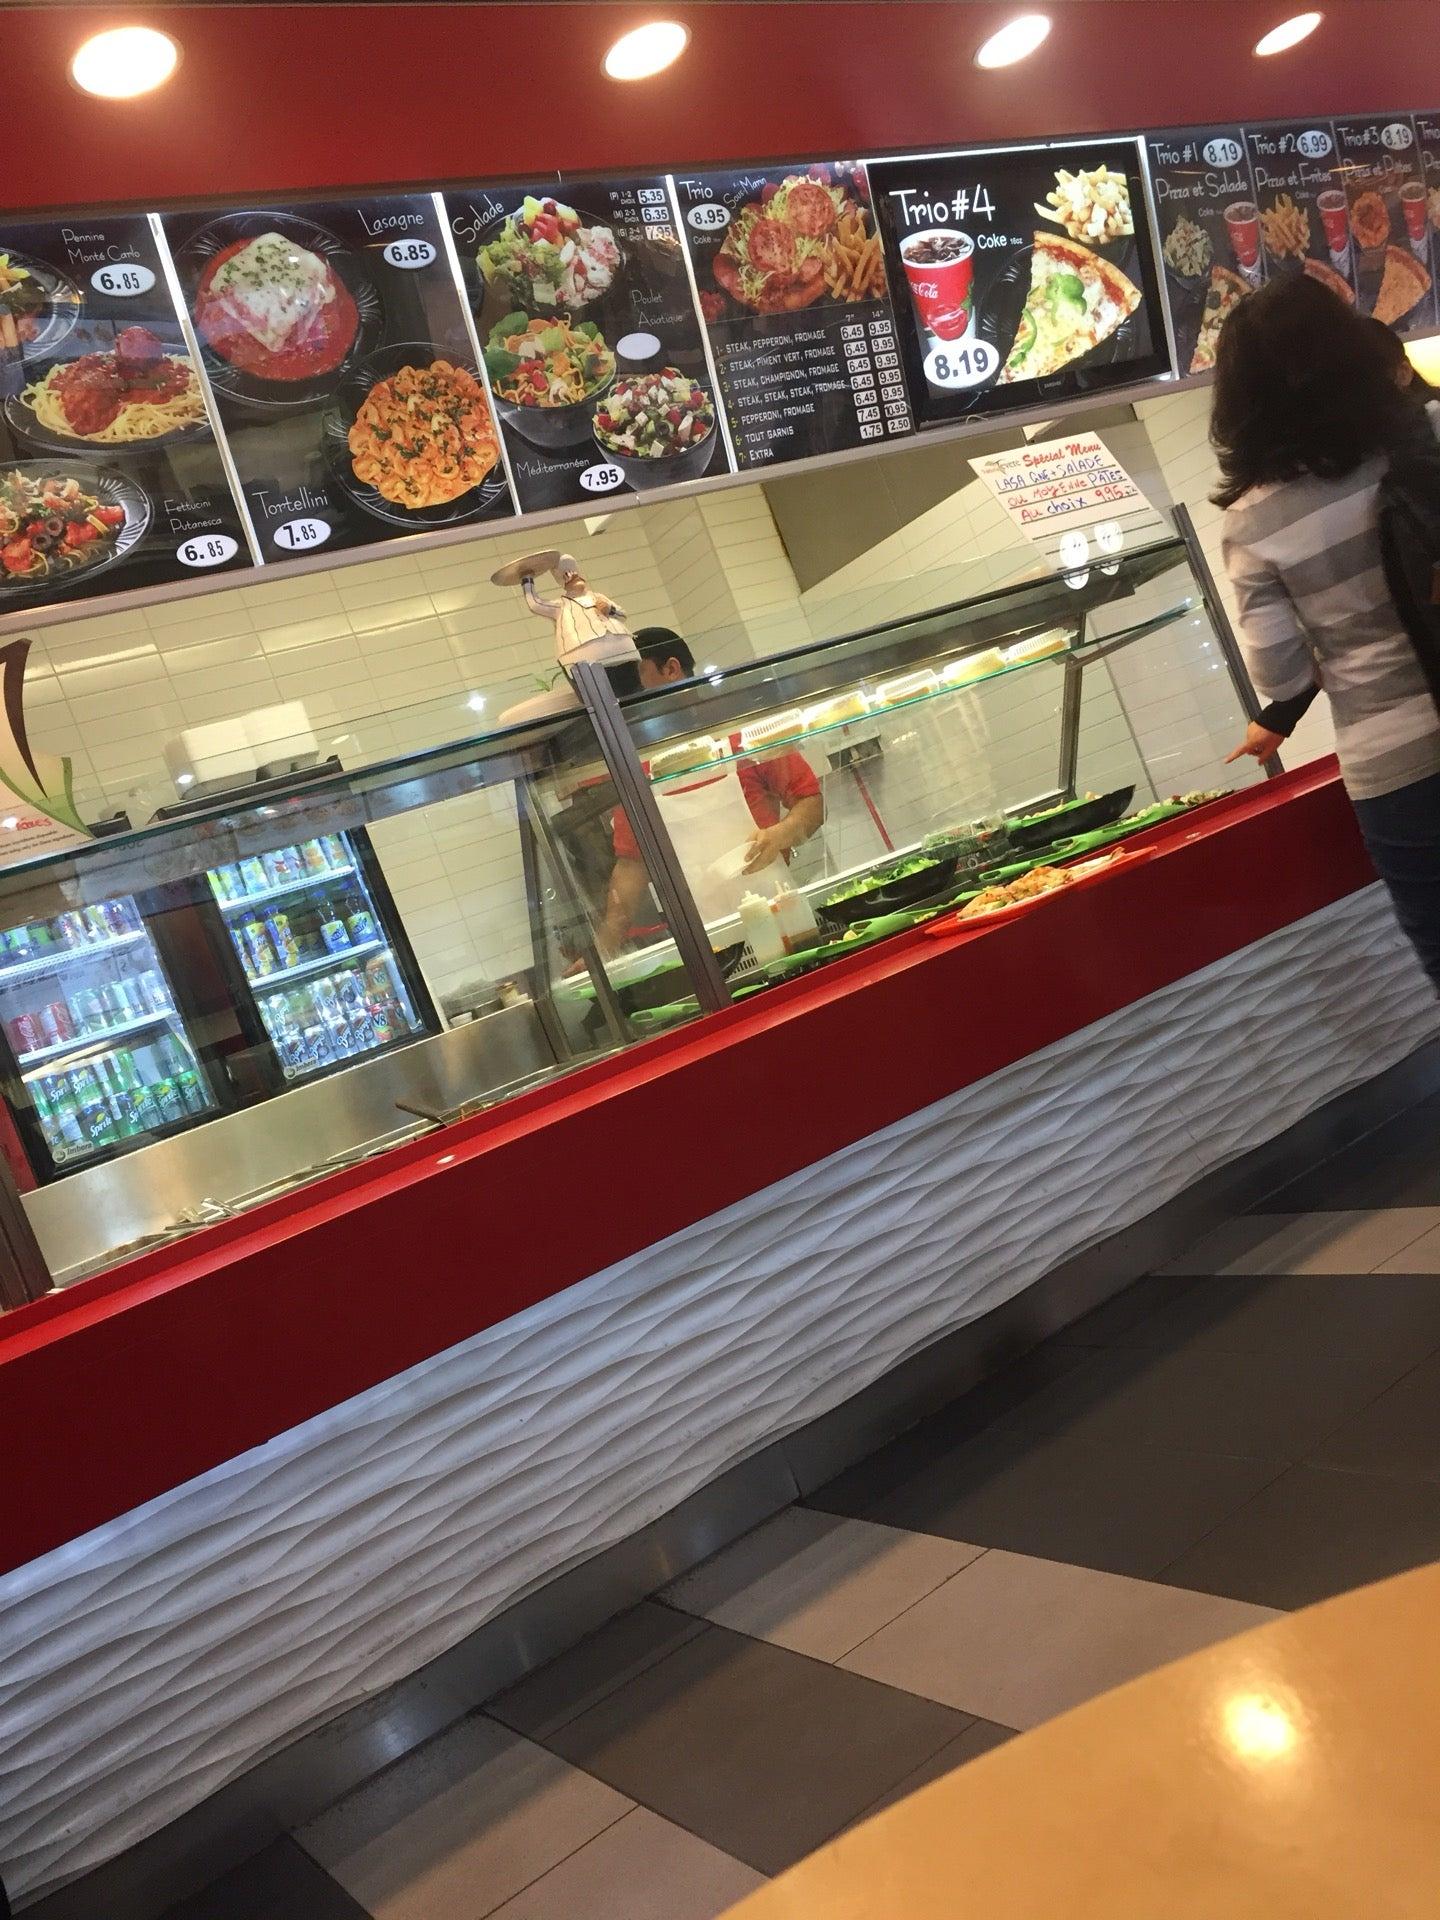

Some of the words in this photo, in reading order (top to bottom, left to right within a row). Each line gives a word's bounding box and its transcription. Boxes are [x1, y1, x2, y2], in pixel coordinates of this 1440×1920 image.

[1248, 134, 1277, 155] Trio
[1300, 134, 1328, 154] 6.99
[1385, 128, 1410, 146] 8.19
[1149, 143, 1180, 165] Trio
[1182, 142, 1199, 163] #1
[1207, 143, 1238, 163] 8.19
[1155, 178, 1190, 204] Pizza
[1192, 181, 1205, 197] et
[1204, 169, 1248, 197] Salade
[1254, 167, 1285, 192] Pizza
[1287, 170, 1299, 186] et
[1298, 162, 1332, 187] Frites
[640, 190, 663, 204] 5.35
[679, 180, 714, 200] Trio
[357, 208, 425, 236] Lasagne
[452, 194, 505, 243] Salade
[644, 208, 668, 222] 6.35
[694, 208, 725, 225] 8.95
[61, 228, 105, 245] Pennine
[693, 234, 712, 245] Coke
[976, 233, 1007, 250] Coke
[106, 244, 141, 262] Carlo
[390, 244, 431, 263] 6.85
[100, 272, 140, 291] 6.85
[631, 288, 664, 307] Poulet
[638, 311, 683, 328] Asiatique
[842, 326, 863, 339] 6.45
[870, 321, 890, 335] 9.95
[726, 340, 752, 354] STEAK,
[752, 334, 794, 350] PEPPERONI,
[794, 329, 826, 342] FROMAGE
[845, 342, 866, 356] 6.45
[873, 338, 893, 351] 9.95
[729, 359, 755, 373] STEAK,
[757, 352, 781, 367] PIMENT
[784, 349, 803, 362] VERT,
[804, 345, 835, 359] FROMAGE
[849, 359, 869, 372] 6.45
[876, 354, 897, 367] 9.95
[934, 347, 989, 380] 8.19
[733, 376, 759, 390] STEAK,
[760, 368, 807, 385] CHAMPIGNON,
[809, 362, 839, 376] FROMAGE
[852, 375, 872, 388] 6.45
[879, 370, 900, 384] 9.95
[737, 393, 763, 407] STEAK,
[764, 388, 789, 403] STEAK,
[790, 383, 814, 397] STEAK,
[815, 378, 846, 393] FROMAGE
[855, 391, 875, 404] 6.45
[882, 386, 903, 400] 9.95
[741, 409, 782, 425] PEPPERONI,
[783, 403, 815, 417] FROMAGE
[858, 408, 878, 421] 7.45
[884, 403, 906, 416] 10.95
[745, 431, 765, 444] TOUT
[766, 425, 794, 440] GARNIS
[862, 424, 882, 437] 1.75
[889, 419, 909, 432] 2.50
[1065, 442, 1101, 457] Menu
[585, 469, 619, 487] 7.95
[252, 486, 329, 519] Tortellini
[1094, 485, 1124, 503] 9.95
[163, 498, 211, 515] Fettucini
[169, 516, 223, 534] Putanesca
[283, 523, 317, 547] 7.85
[184, 540, 224, 562] 6.85
[373, 1013, 387, 1026] V8
[90, 1117, 113, 1137] Sprite
